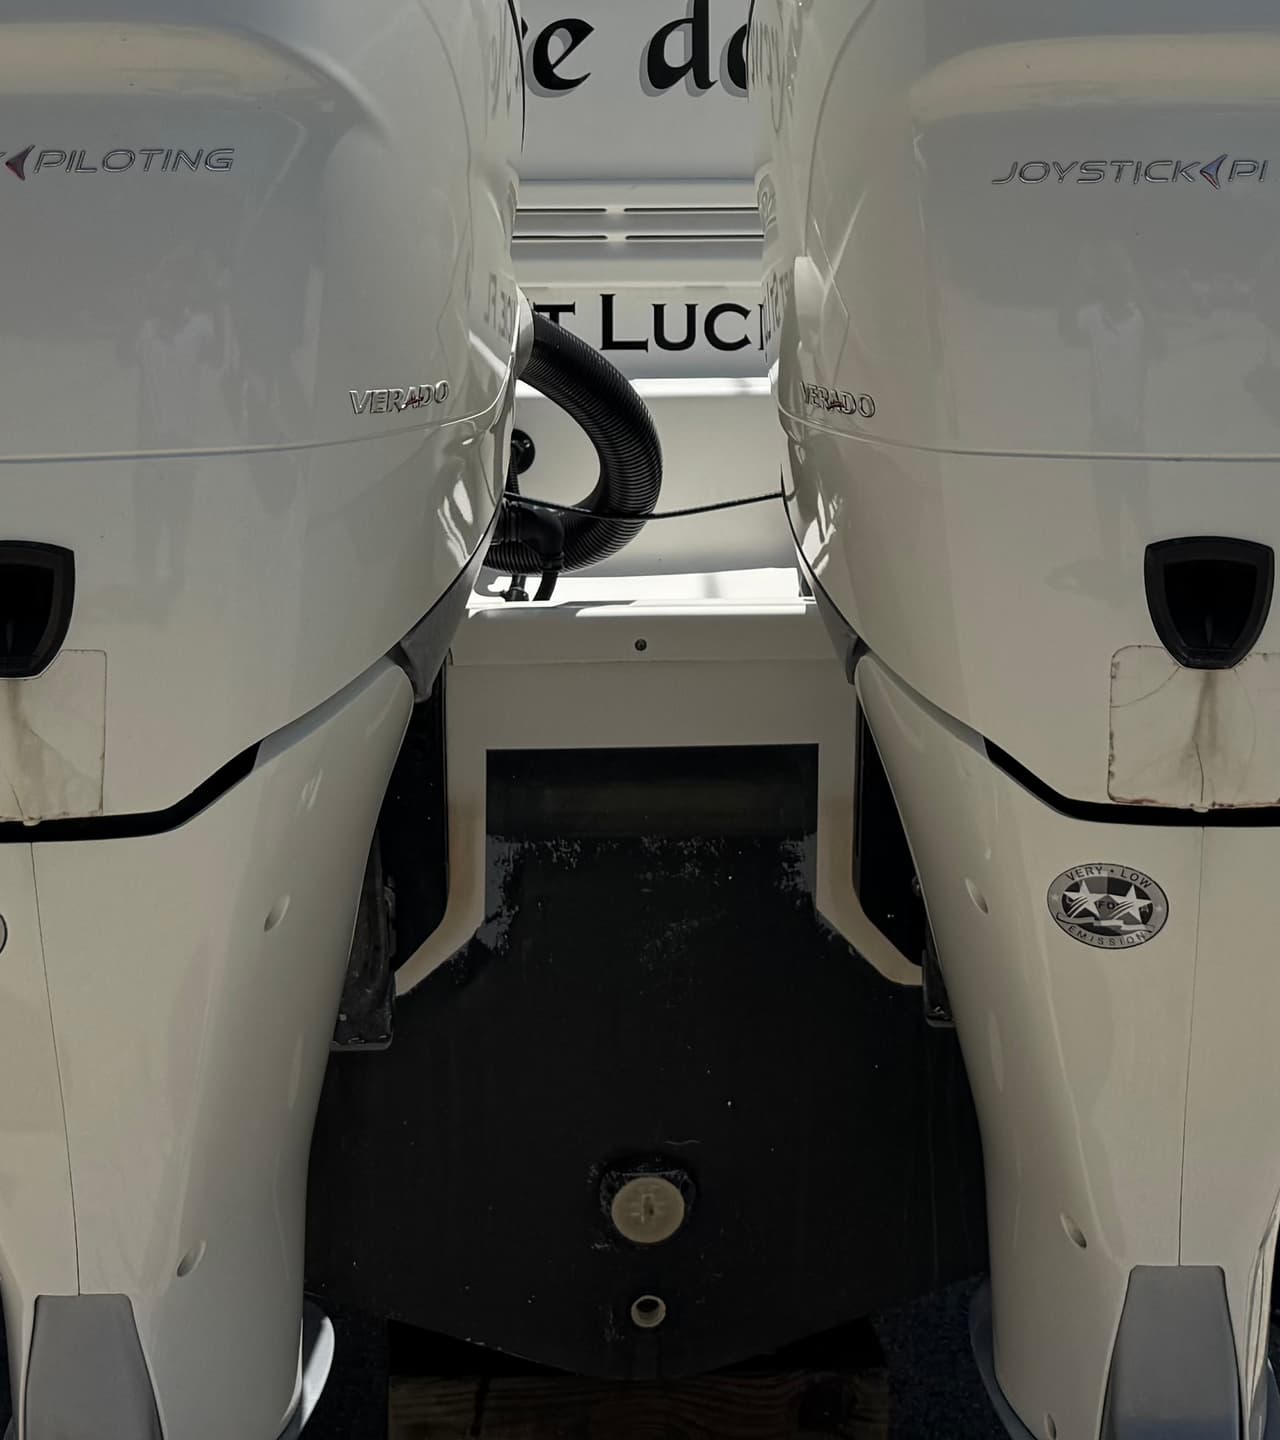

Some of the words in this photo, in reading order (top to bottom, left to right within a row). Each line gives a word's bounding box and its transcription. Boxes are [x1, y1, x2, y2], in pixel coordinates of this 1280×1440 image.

[521, 16, 595, 94] e
[33, 148, 236, 174] PILOTING
[991, 160, 1202, 185] JOYSTICK
[527, 297, 576, 325] T
[349, 380, 450, 415] VERADO
[799, 380, 876, 418] VERADO
[1065, 866, 1103, 881] VERY
[1120, 868, 1152, 889] LOW
[1067, 924, 1147, 946] EMISSION
